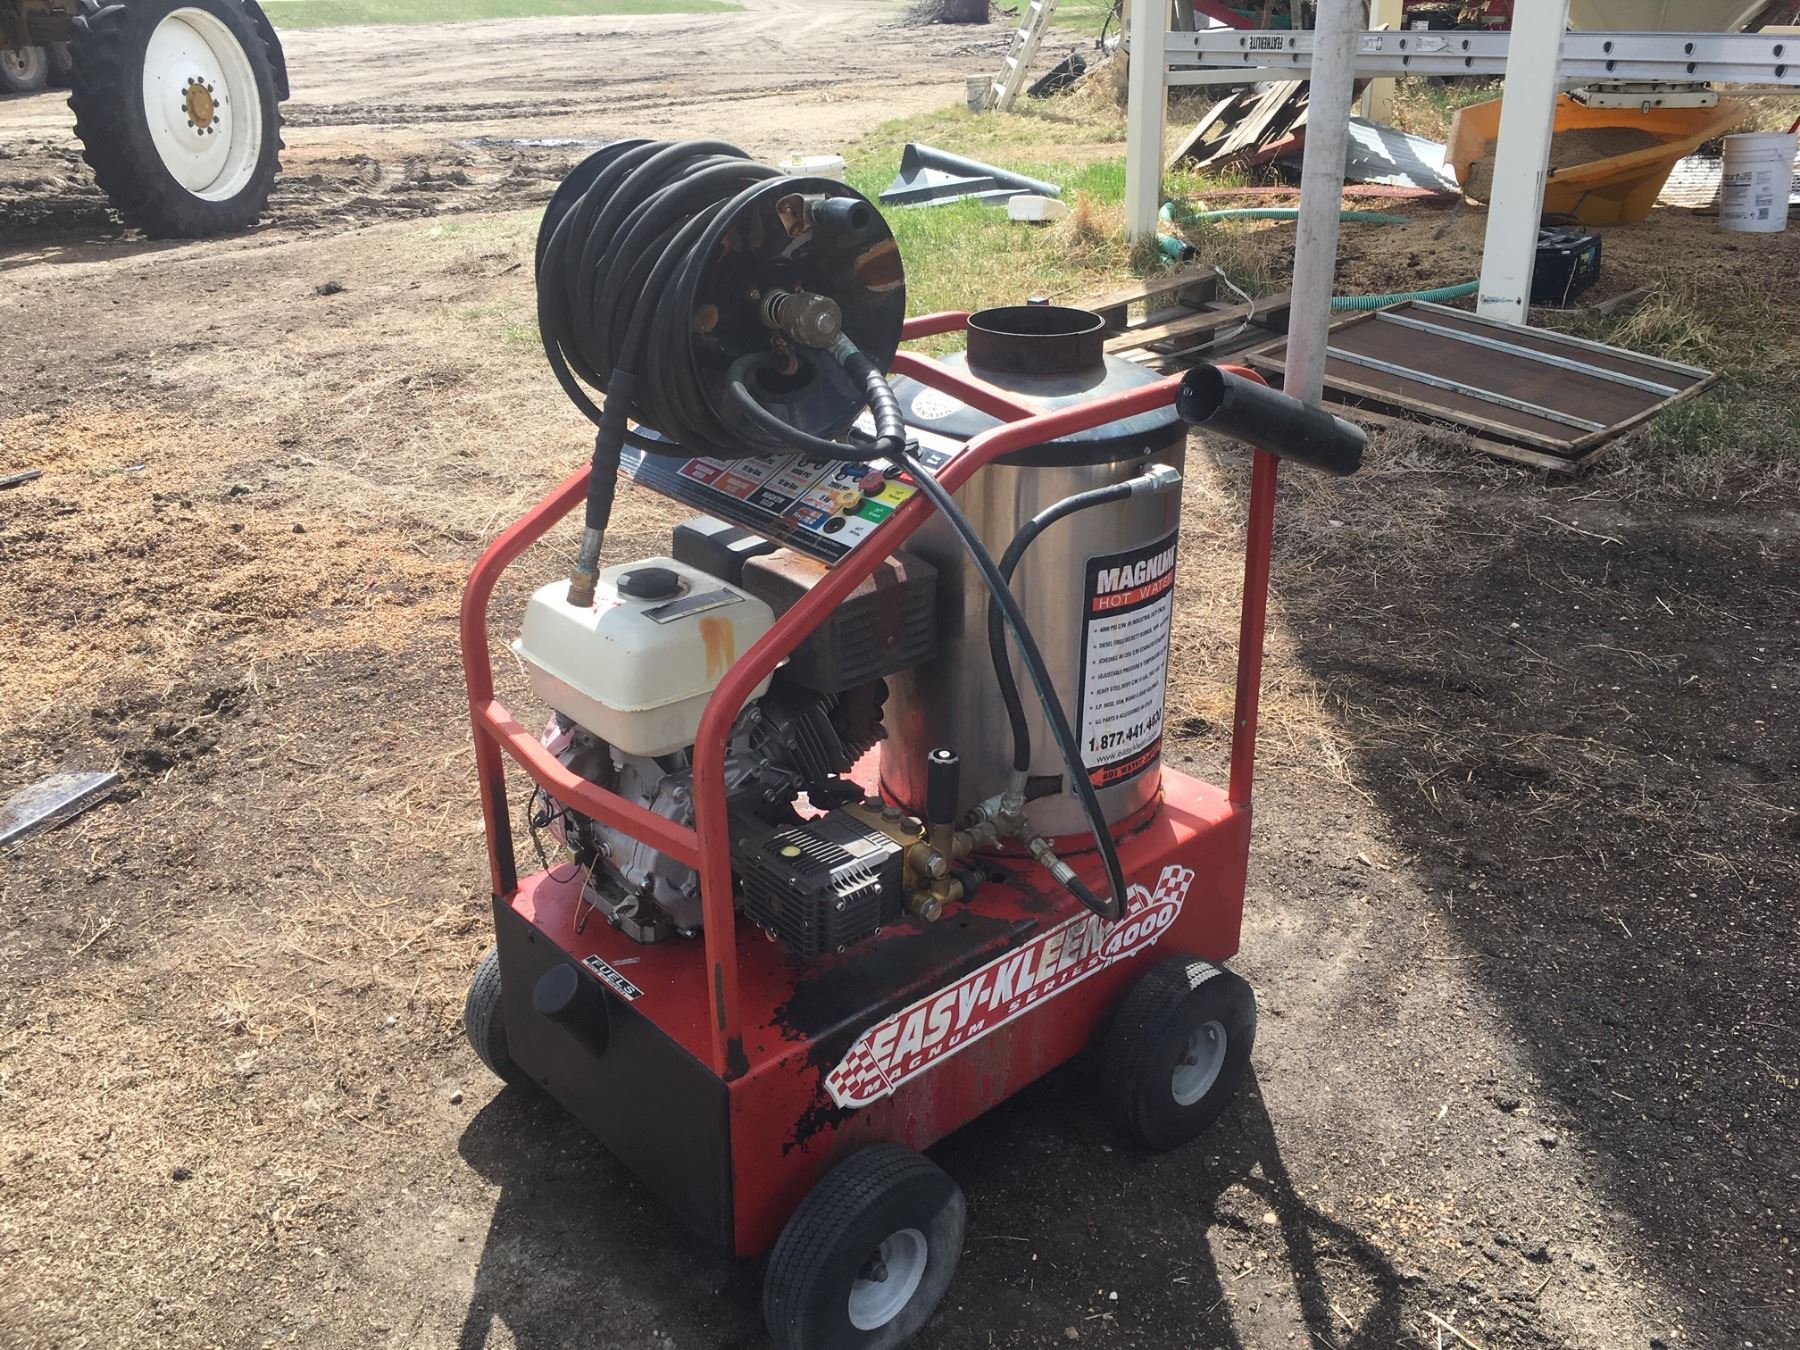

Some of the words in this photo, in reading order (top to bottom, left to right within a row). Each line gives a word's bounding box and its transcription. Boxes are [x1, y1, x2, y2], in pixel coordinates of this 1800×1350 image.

[1249, 36, 1284, 50] FEATHERLITE
[1097, 545, 1175, 594] MAGNUM
[1100, 592, 1132, 609] HOT
[1140, 571, 1173, 599] WATER
[1106, 903, 1175, 954] 4000
[591, 959, 636, 994] FUELS
[870, 915, 1110, 1070] EASY-KLEEN
[862, 1021, 984, 1098] MAGNUM
[1008, 956, 1101, 1014] SERIES
